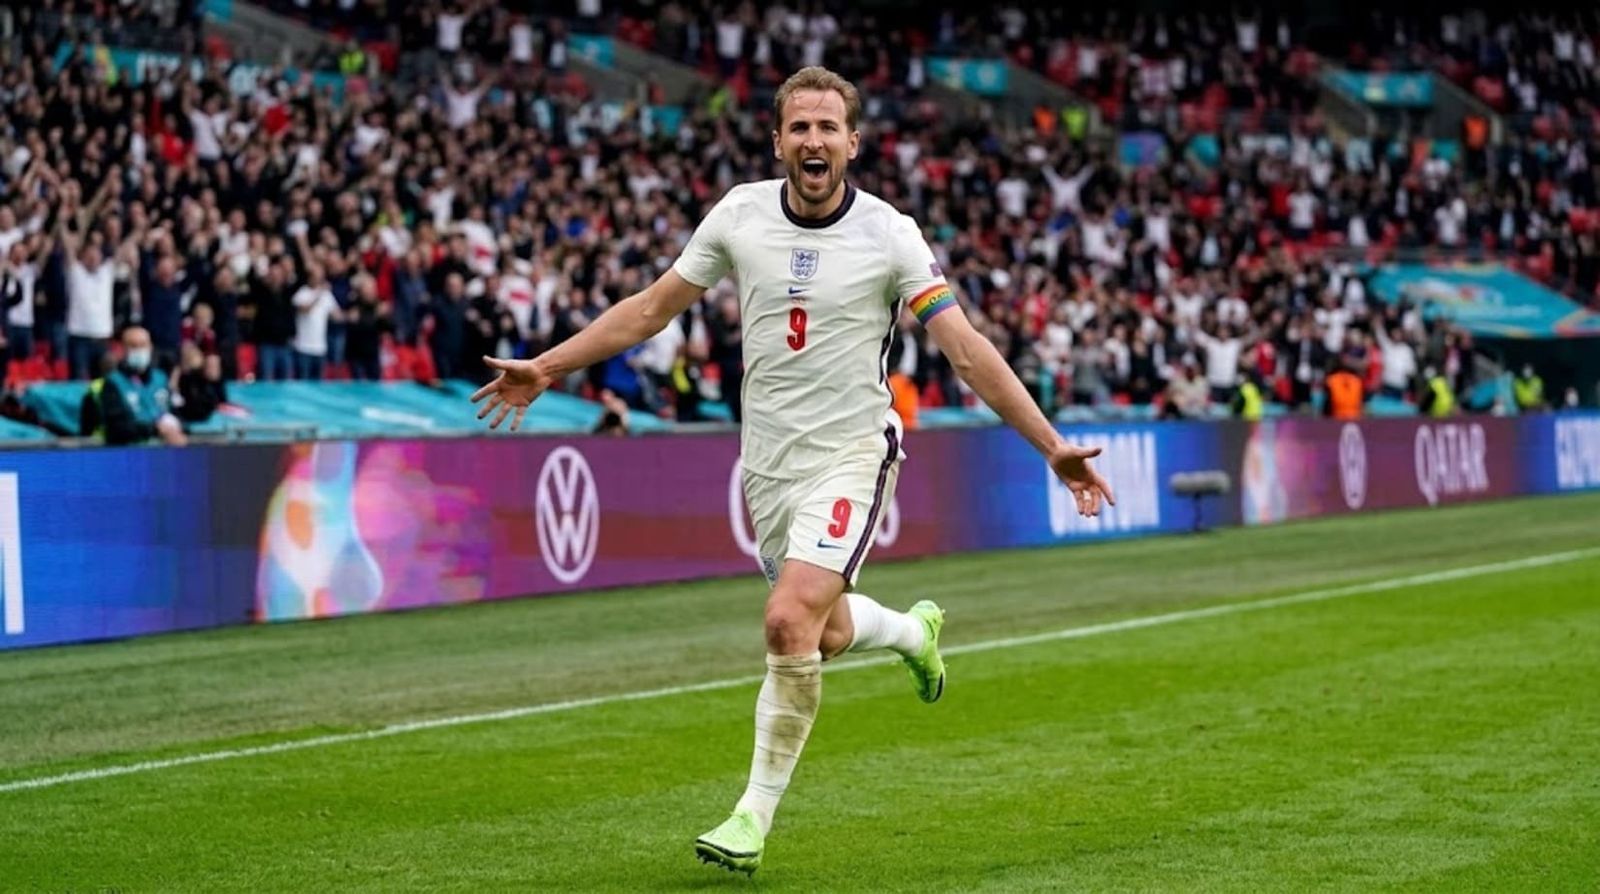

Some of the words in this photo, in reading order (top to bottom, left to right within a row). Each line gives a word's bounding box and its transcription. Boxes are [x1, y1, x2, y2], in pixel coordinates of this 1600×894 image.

[786, 307, 807, 352] 9
[1414, 423, 1490, 505] QATAR
[827, 497, 852, 538] 9
